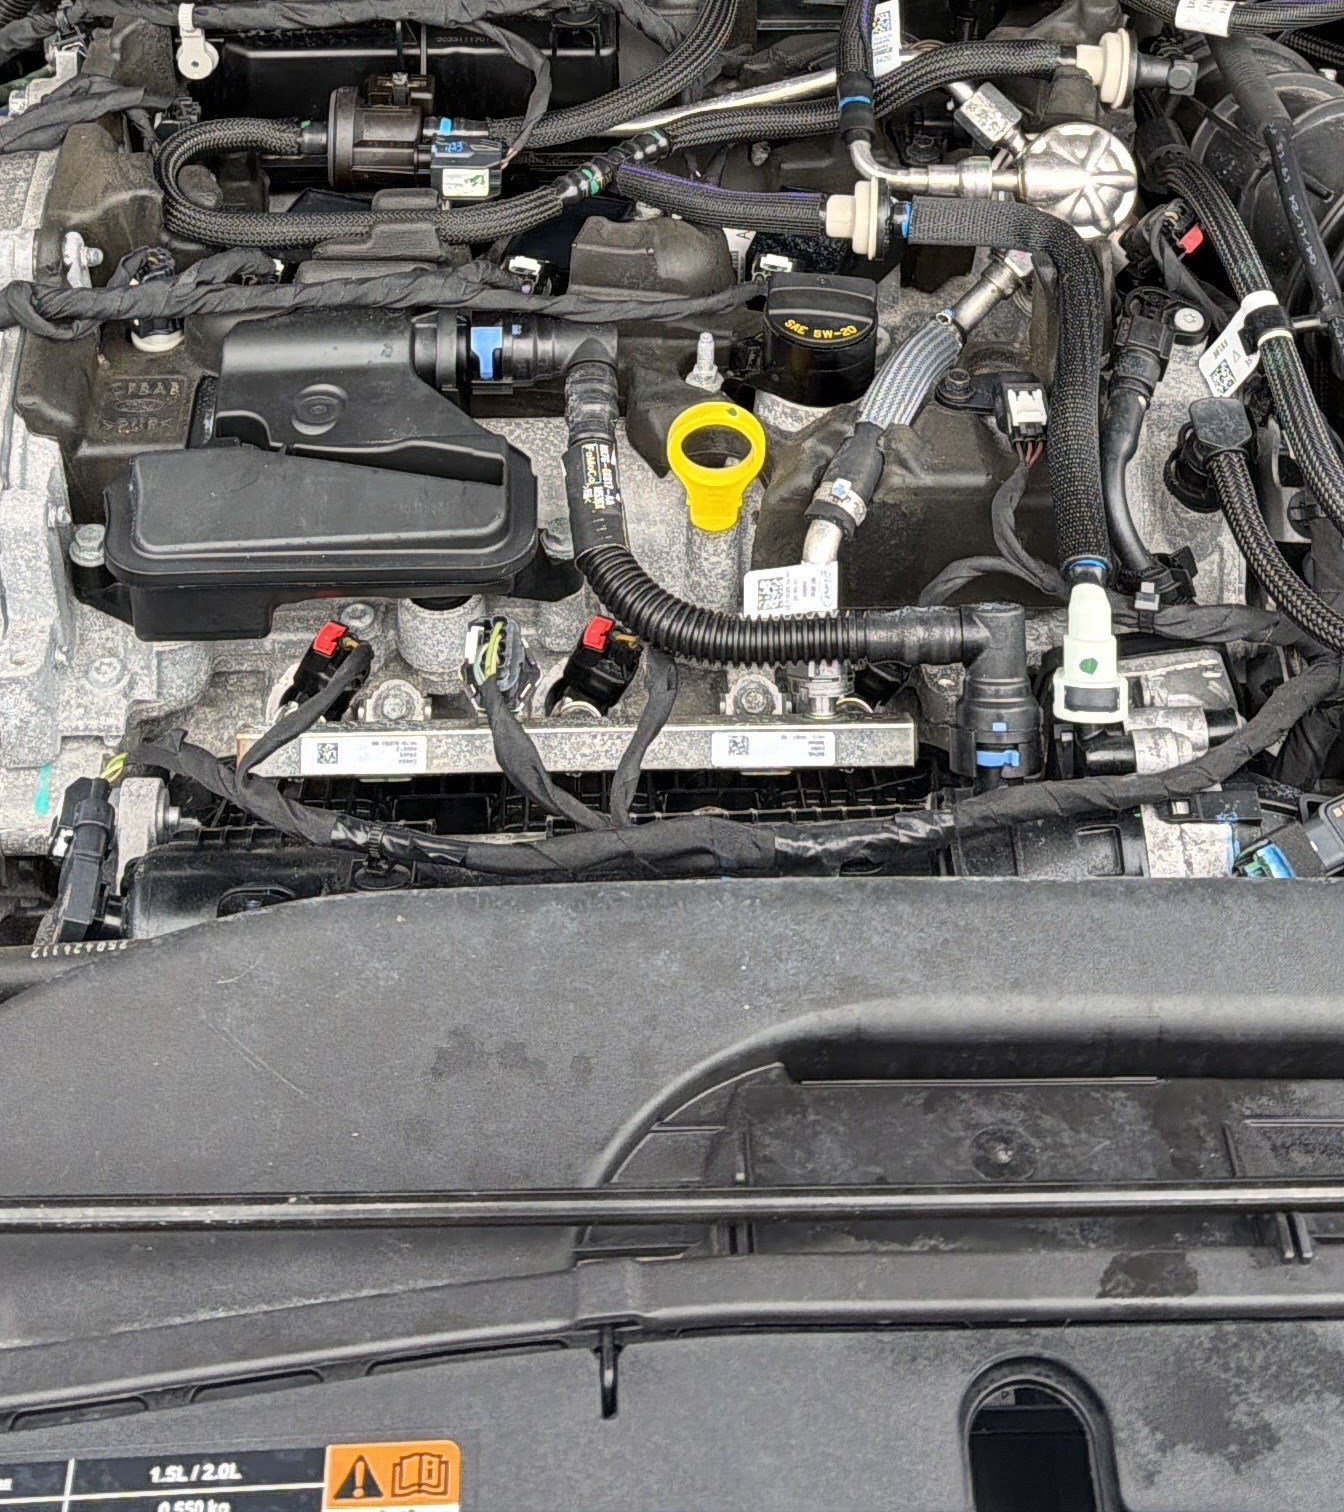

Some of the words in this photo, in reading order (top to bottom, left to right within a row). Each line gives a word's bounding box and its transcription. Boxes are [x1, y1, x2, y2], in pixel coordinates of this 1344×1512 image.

[784, 318, 809, 335] SAE
[812, 324, 858, 339] 5W-20
[149, 1465, 187, 1484] 1.5L
[203, 1462, 242, 1481] 2.0L
